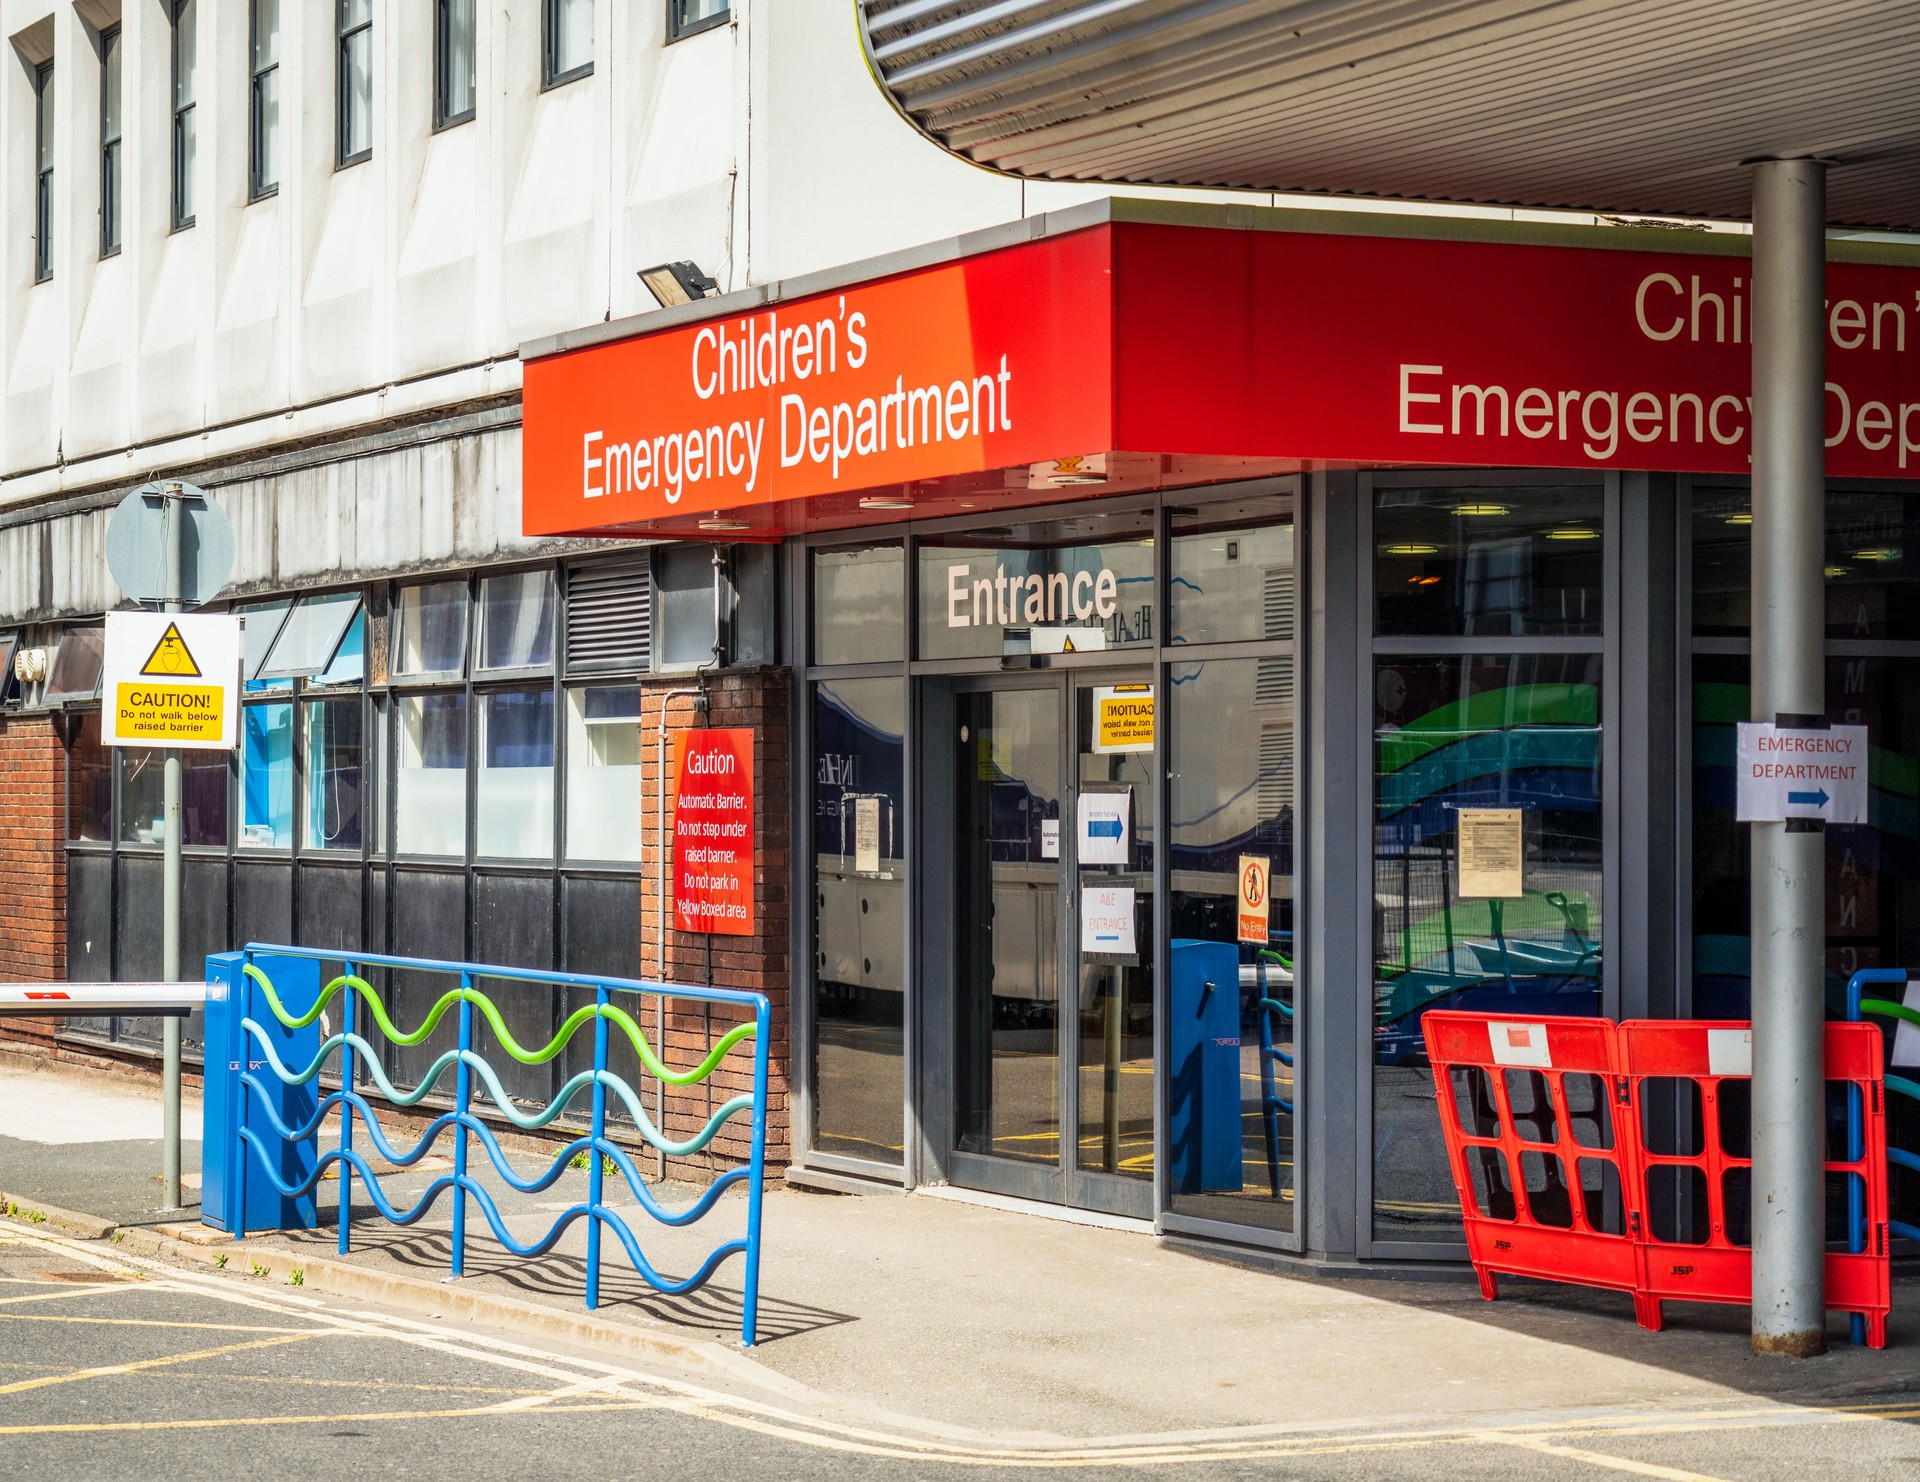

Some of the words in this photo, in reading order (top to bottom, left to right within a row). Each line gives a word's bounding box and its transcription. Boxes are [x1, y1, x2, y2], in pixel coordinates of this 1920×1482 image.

[692, 296, 867, 400] Children's
[1399, 363, 1753, 461] Emergenc
[583, 416, 765, 504] Emergency
[780, 352, 1012, 479] Department
[948, 562, 1117, 628] Entrance
[130, 692, 210, 708] CAUTION!
[121, 709, 134, 719] Do
[139, 711, 155, 719] not
[161, 711, 182, 720] walk
[188, 712, 217, 721] below
[134, 722, 166, 731] raised
[170, 723, 203, 732] barrier
[1758, 737, 1852, 753] EMERGENCY
[687, 748, 735, 775] Caution
[1752, 764, 1857, 780] DEPARTMENT
[678, 793, 715, 809] Automatic
[717, 793, 747, 809] Barrier.
[677, 820, 687, 836] Do
[689, 821, 701, 837] not
[703, 821, 720, 840] stop
[722, 820, 747, 837] under
[685, 846, 706, 862] raised
[708, 846, 737, 863] barrier.
[684, 873, 694, 888] Do
[696, 873, 708, 889] not
[710, 873, 728, 892] park
[730, 874, 738, 890] in
[1100, 892, 1116, 906] A&E
[677, 898, 700, 915] Yellow
[701, 900, 725, 917] Boxed
[727, 904, 747, 918] area
[1089, 917, 1127, 931] ENTRANCE
[1240, 920, 1249, 931] No
[1250, 921, 1265, 935] Entry
[1494, 1240, 1511, 1250] JSP
[1670, 1266, 1694, 1275] JSP
